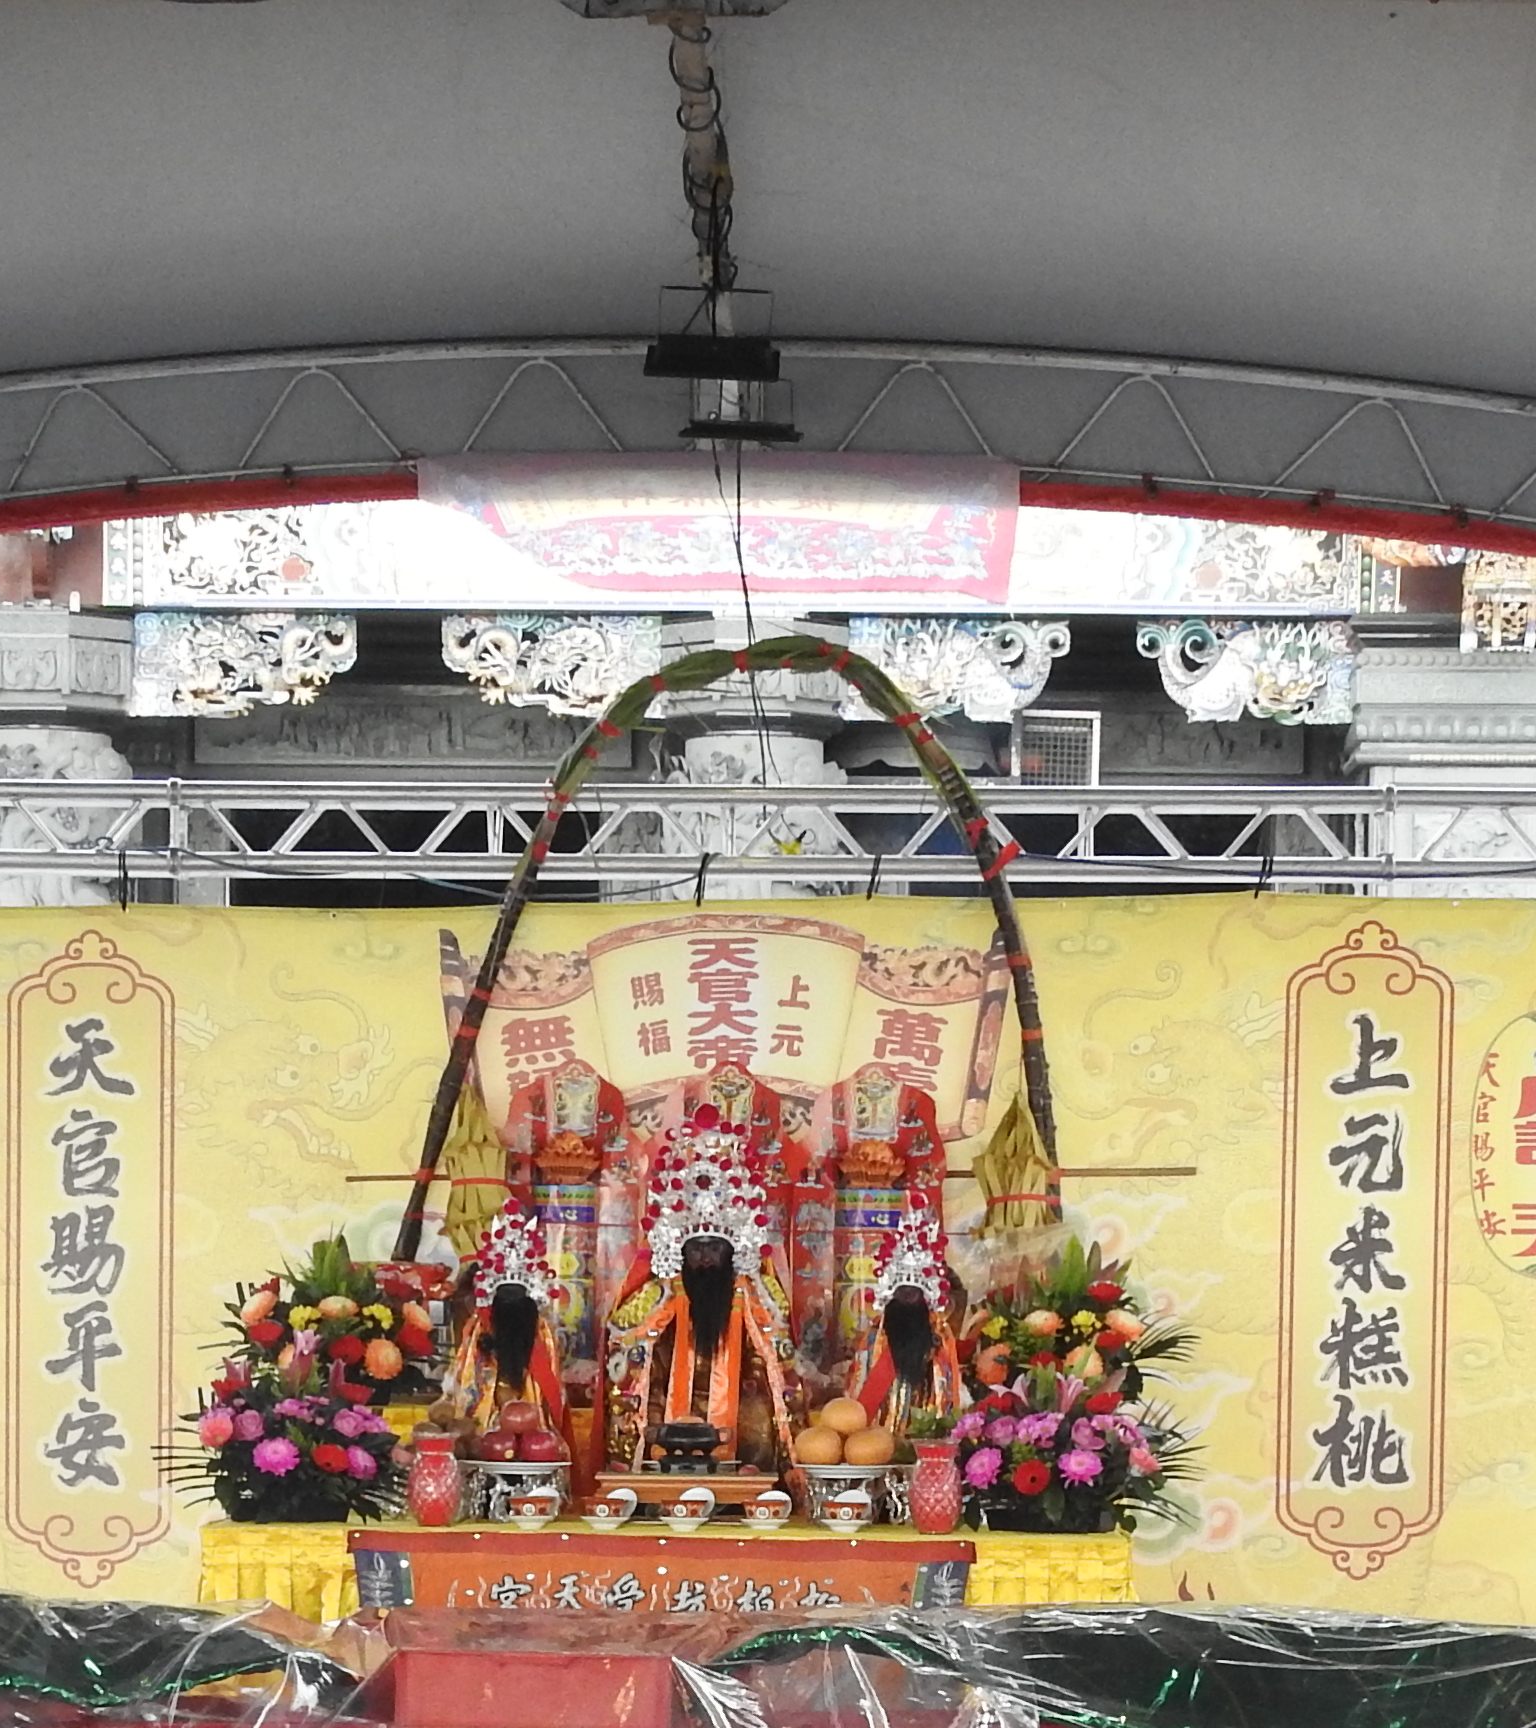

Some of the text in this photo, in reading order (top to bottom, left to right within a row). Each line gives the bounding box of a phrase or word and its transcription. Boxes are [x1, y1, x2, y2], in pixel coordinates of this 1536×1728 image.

[630, 972, 672, 1057] 賜福
[687, 936, 759, 1068] 天官大帝
[770, 974, 811, 1057] 上元
[42, 1016, 135, 1488] 天官賜平安
[1312, 1014, 1410, 1488] 上元米糕桃
